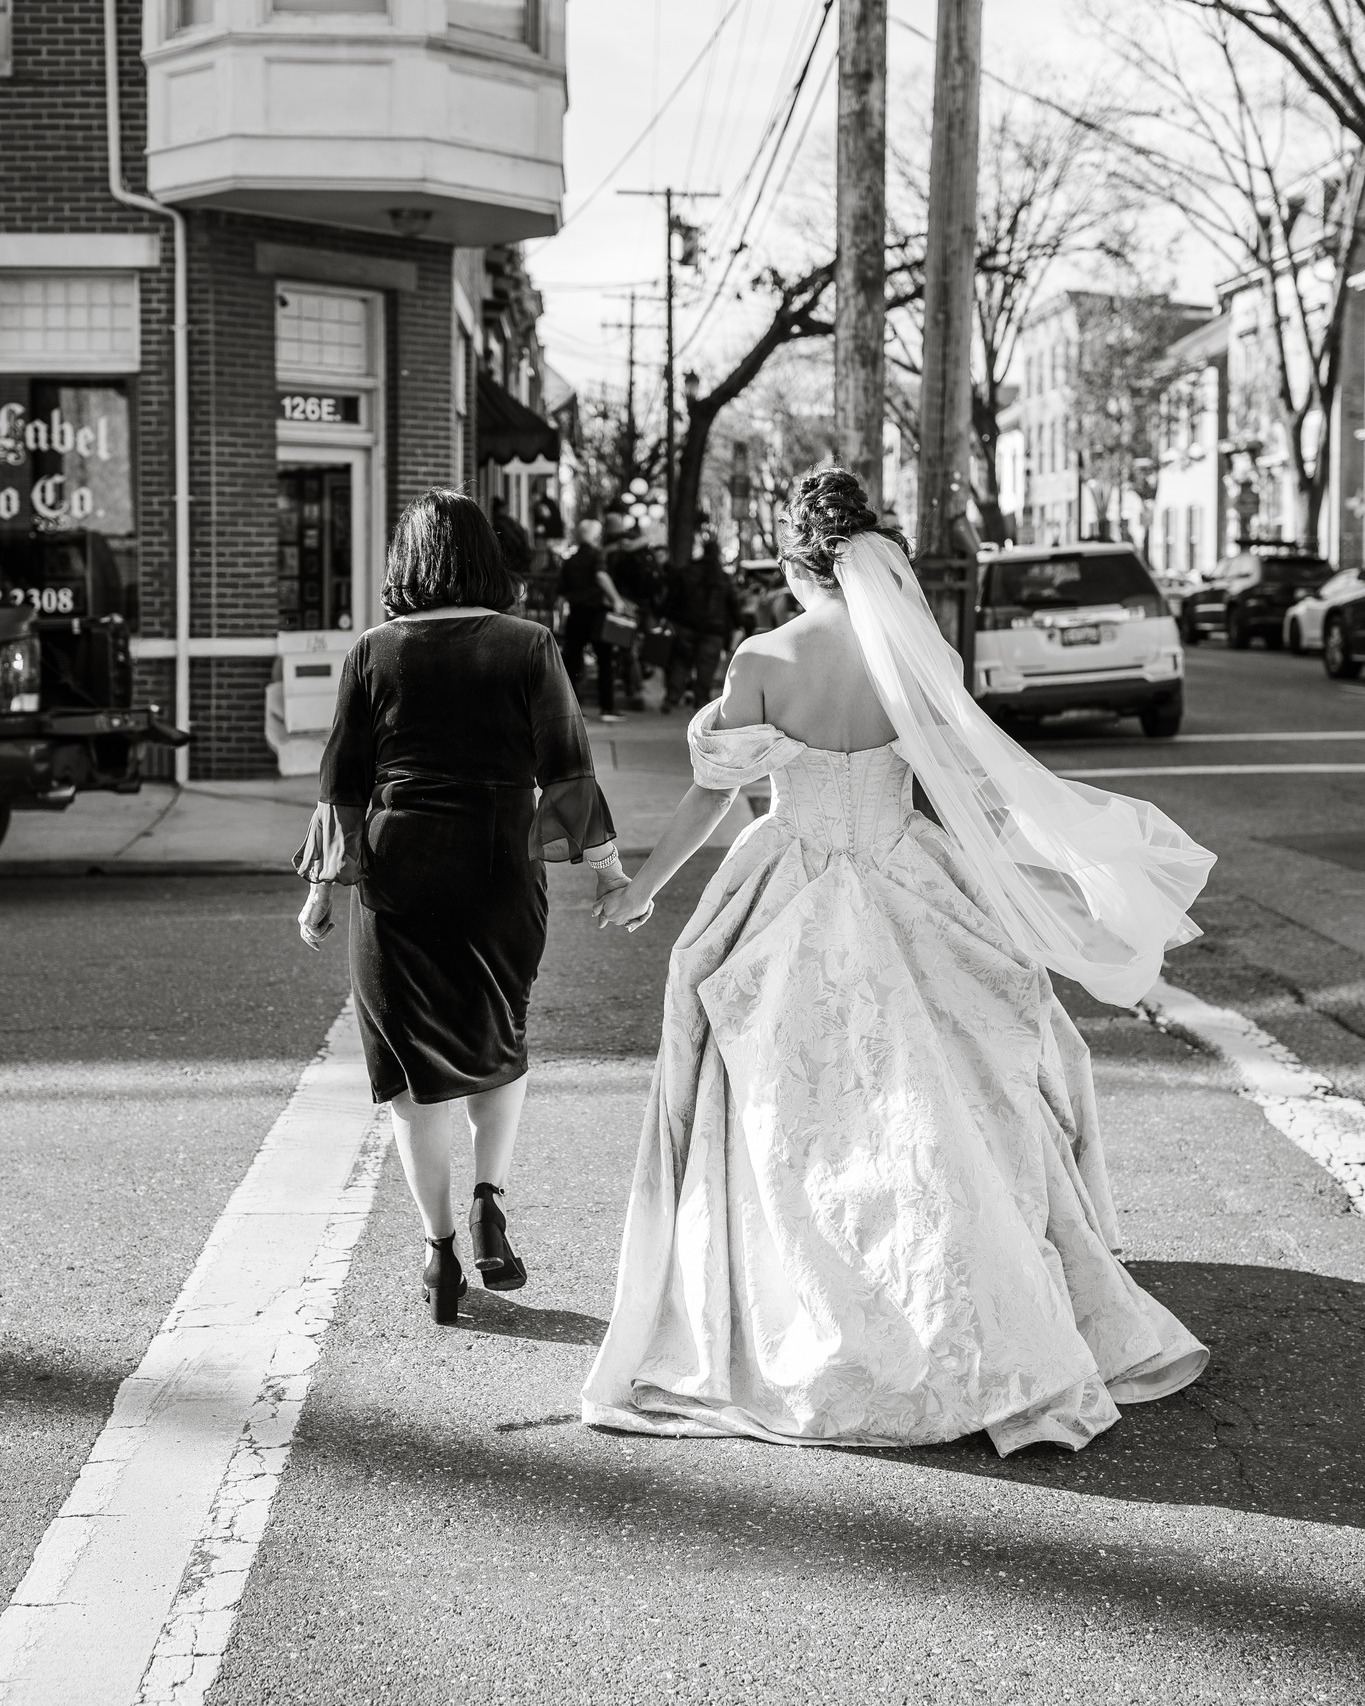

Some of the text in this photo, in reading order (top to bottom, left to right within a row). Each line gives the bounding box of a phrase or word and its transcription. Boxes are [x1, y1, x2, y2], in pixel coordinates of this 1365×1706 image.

[0, 402, 111, 466] Label
[279, 396, 342, 422] 126E.
[30, 473, 105, 531] Co.
